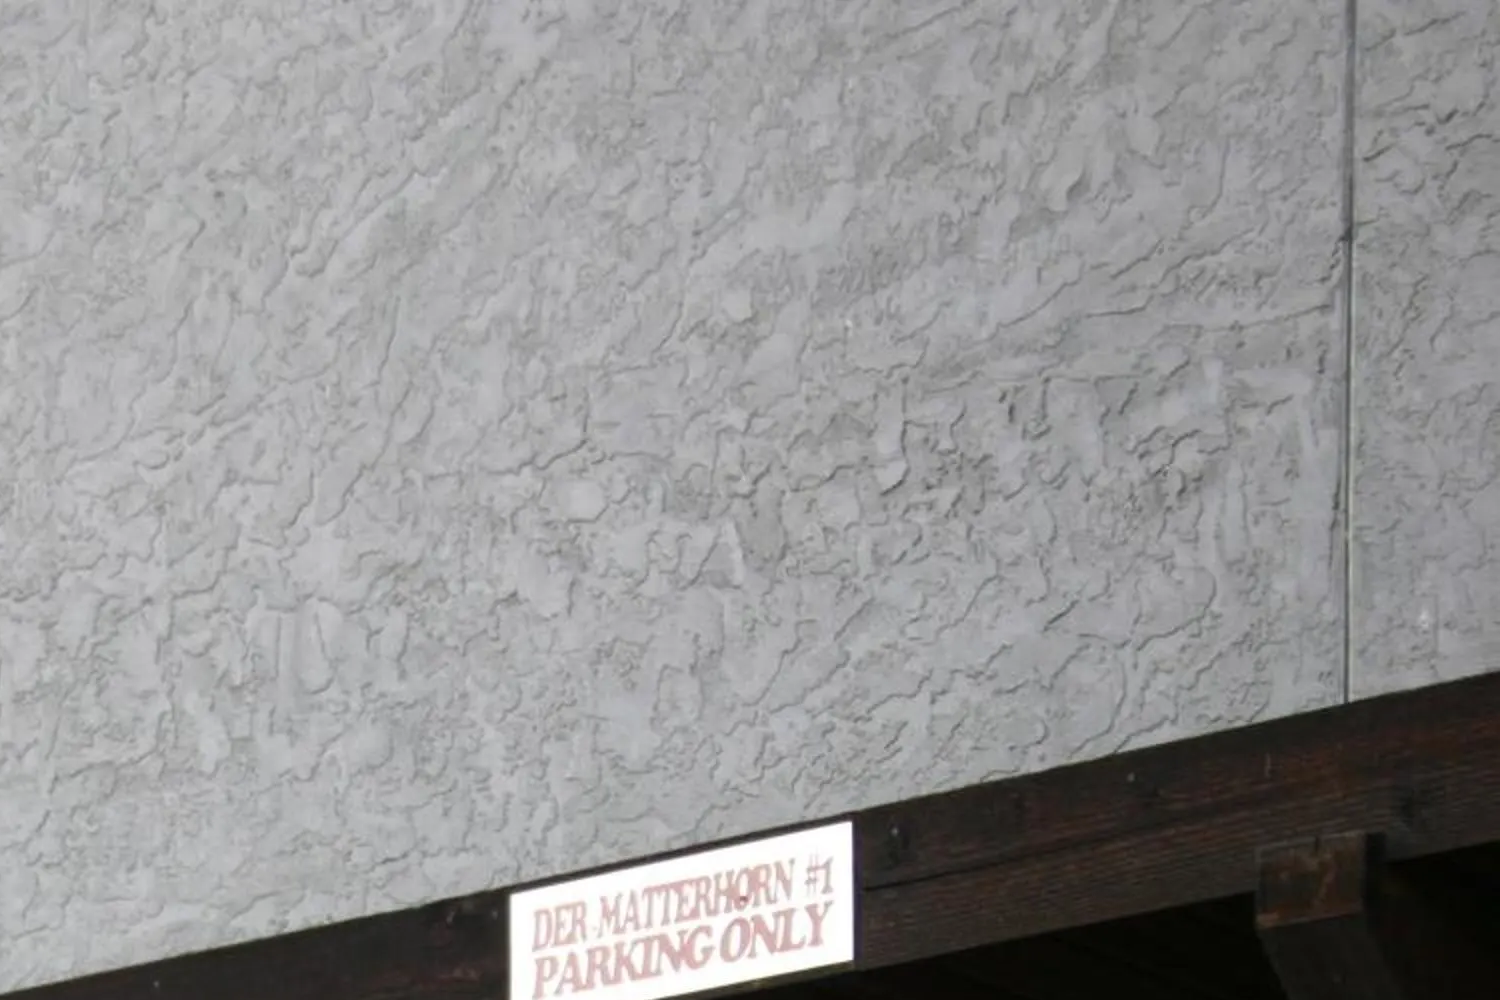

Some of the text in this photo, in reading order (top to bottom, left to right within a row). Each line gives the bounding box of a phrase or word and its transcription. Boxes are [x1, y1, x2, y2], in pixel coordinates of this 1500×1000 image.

[531, 851, 834, 952] DER MATTERHORN #1
[531, 900, 835, 1000] PARKING ONLY
